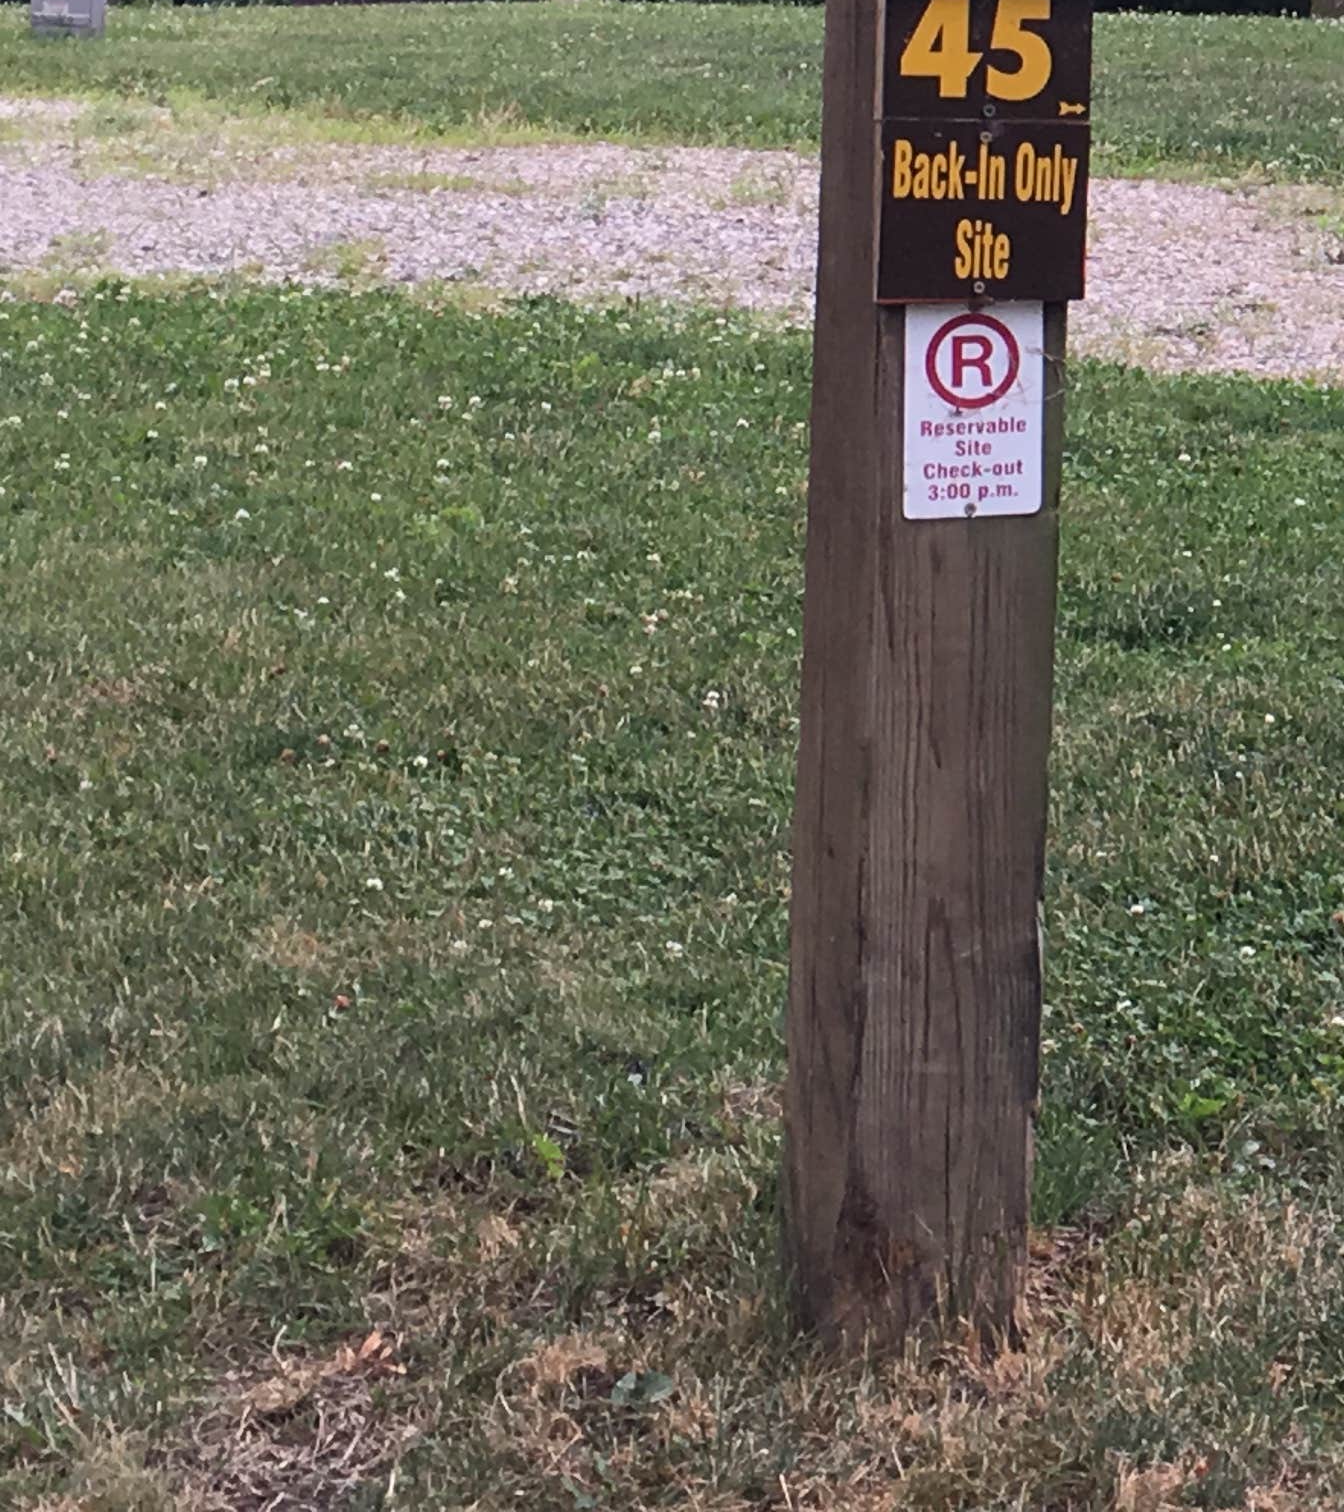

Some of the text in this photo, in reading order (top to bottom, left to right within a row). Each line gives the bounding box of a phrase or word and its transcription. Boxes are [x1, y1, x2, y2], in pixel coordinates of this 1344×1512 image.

[892, 138, 1078, 216] Back-In Only
[954, 218, 1011, 281] Site
[951, 334, 994, 388] R
[919, 416, 1028, 438] Reservable
[955, 440, 993, 457] Site
[922, 459, 1024, 479] Check-out
[927, 484, 1020, 504] 3:00 p.m.
